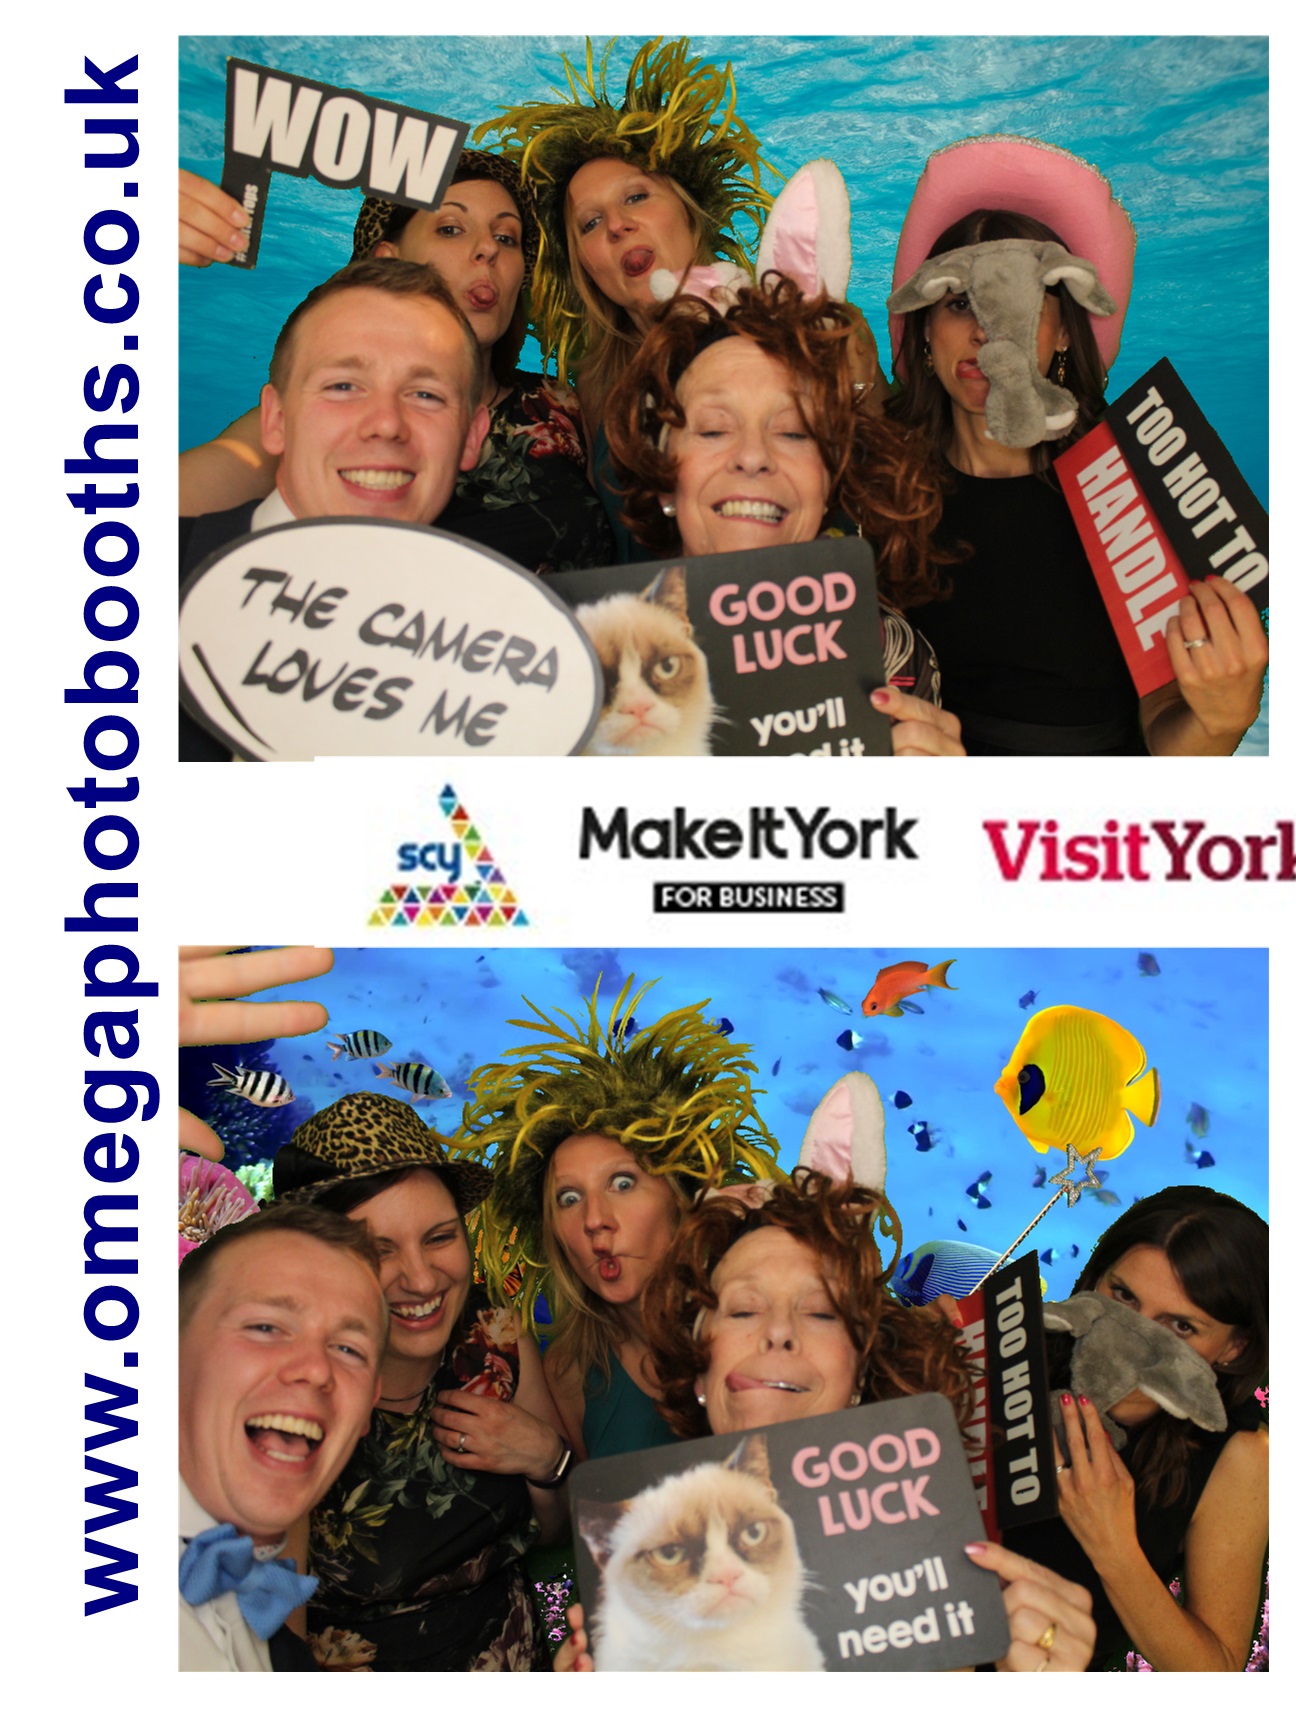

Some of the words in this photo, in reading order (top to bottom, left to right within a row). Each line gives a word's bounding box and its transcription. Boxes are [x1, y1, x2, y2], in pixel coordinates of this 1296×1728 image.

[232, 67, 458, 204] WOW
[1126, 385, 1187, 467] TOO
[1162, 452, 1237, 539] HOT
[1208, 525, 1269, 593] TO
[1076, 445, 1184, 652] HANDLE
[709, 571, 856, 626] GOOD
[241, 567, 348, 629] THE
[358, 603, 559, 694] CAMERA
[732, 620, 848, 674] LUCK
[241, 640, 414, 720] LOVES
[419, 689, 508, 747] ME
[749, 697, 846, 746] you'll
[995, 1276, 1027, 1358] TOO
[1002, 1360, 1035, 1441] HOT
[791, 1427, 941, 1488] GOOD
[1009, 1447, 1040, 1506] TO
[818, 1475, 941, 1536] LUCK
[843, 1556, 949, 1614] you'll
[837, 1606, 941, 1659] need
[944, 1601, 975, 1638] it
